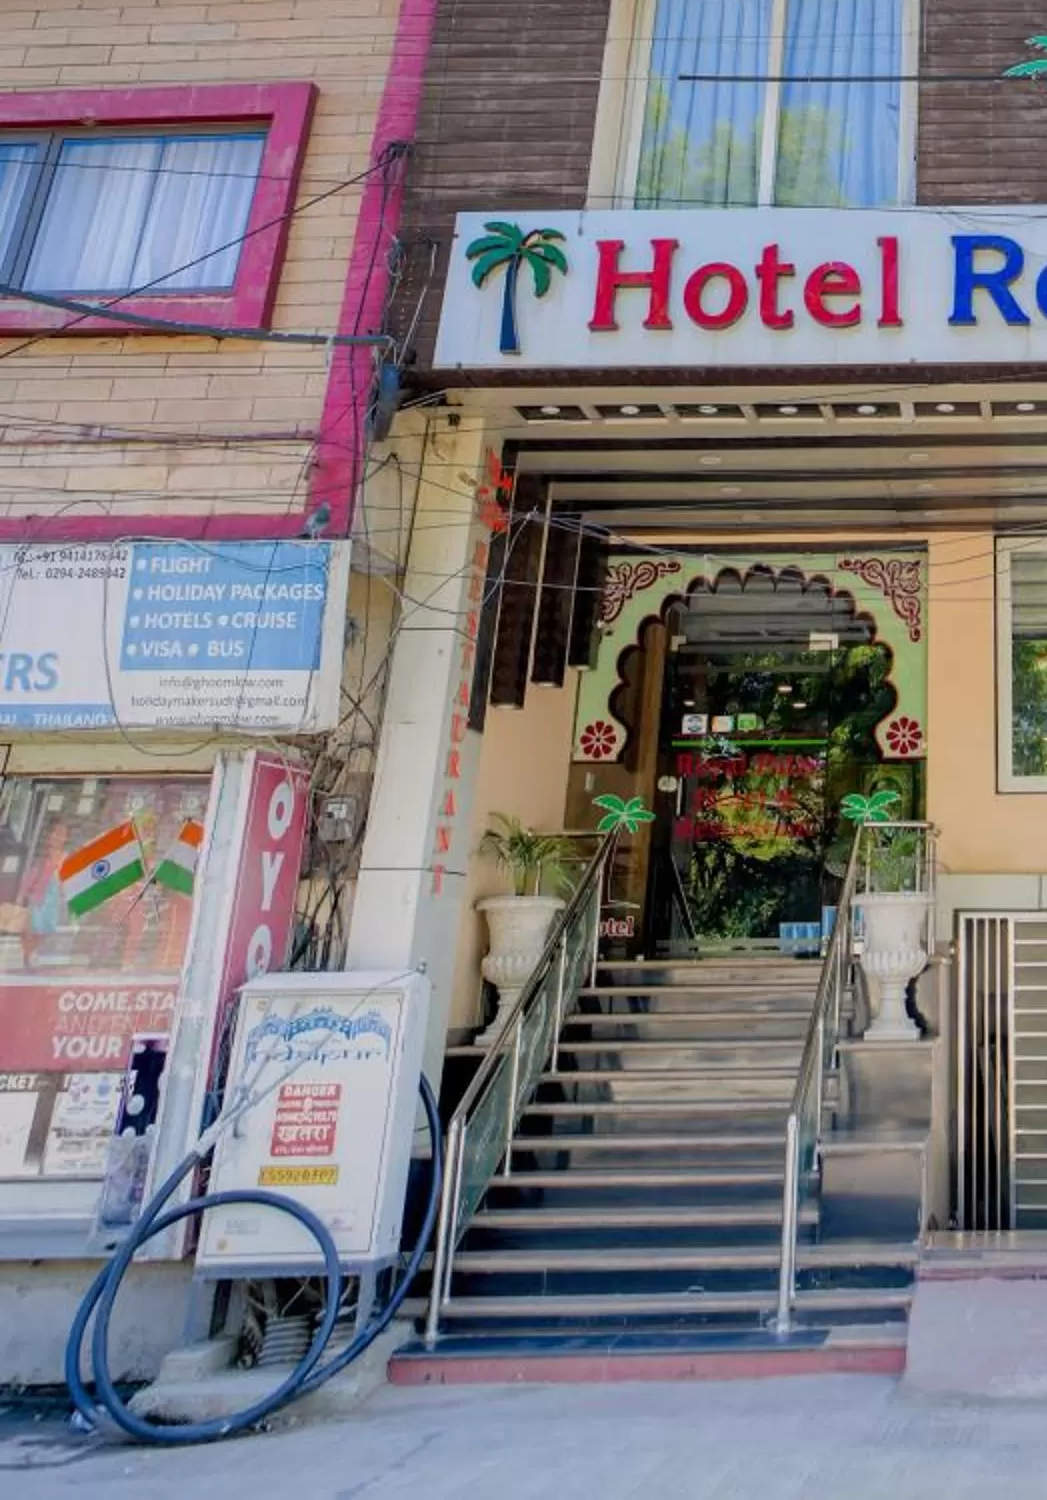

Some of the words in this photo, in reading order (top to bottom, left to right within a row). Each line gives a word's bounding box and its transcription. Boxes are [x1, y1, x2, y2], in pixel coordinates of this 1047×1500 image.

[587, 235, 902, 331] Hotel
[151, 556, 213, 574] FLIGHT
[147, 584, 226, 601] HOLIDAY
[231, 583, 324, 601] PACKAGES
[144, 612, 213, 629] HOTELS
[231, 612, 297, 629] CRUISE
[142, 640, 183, 657] VISA
[207, 640, 244, 657] BUS
[2, 652, 60, 692] RS
[246, 781, 296, 981] OYO
[599, 915, 635, 937] otel
[51, 1035, 123, 1059] YOUR
[284, 1086, 337, 1097] DANGER
